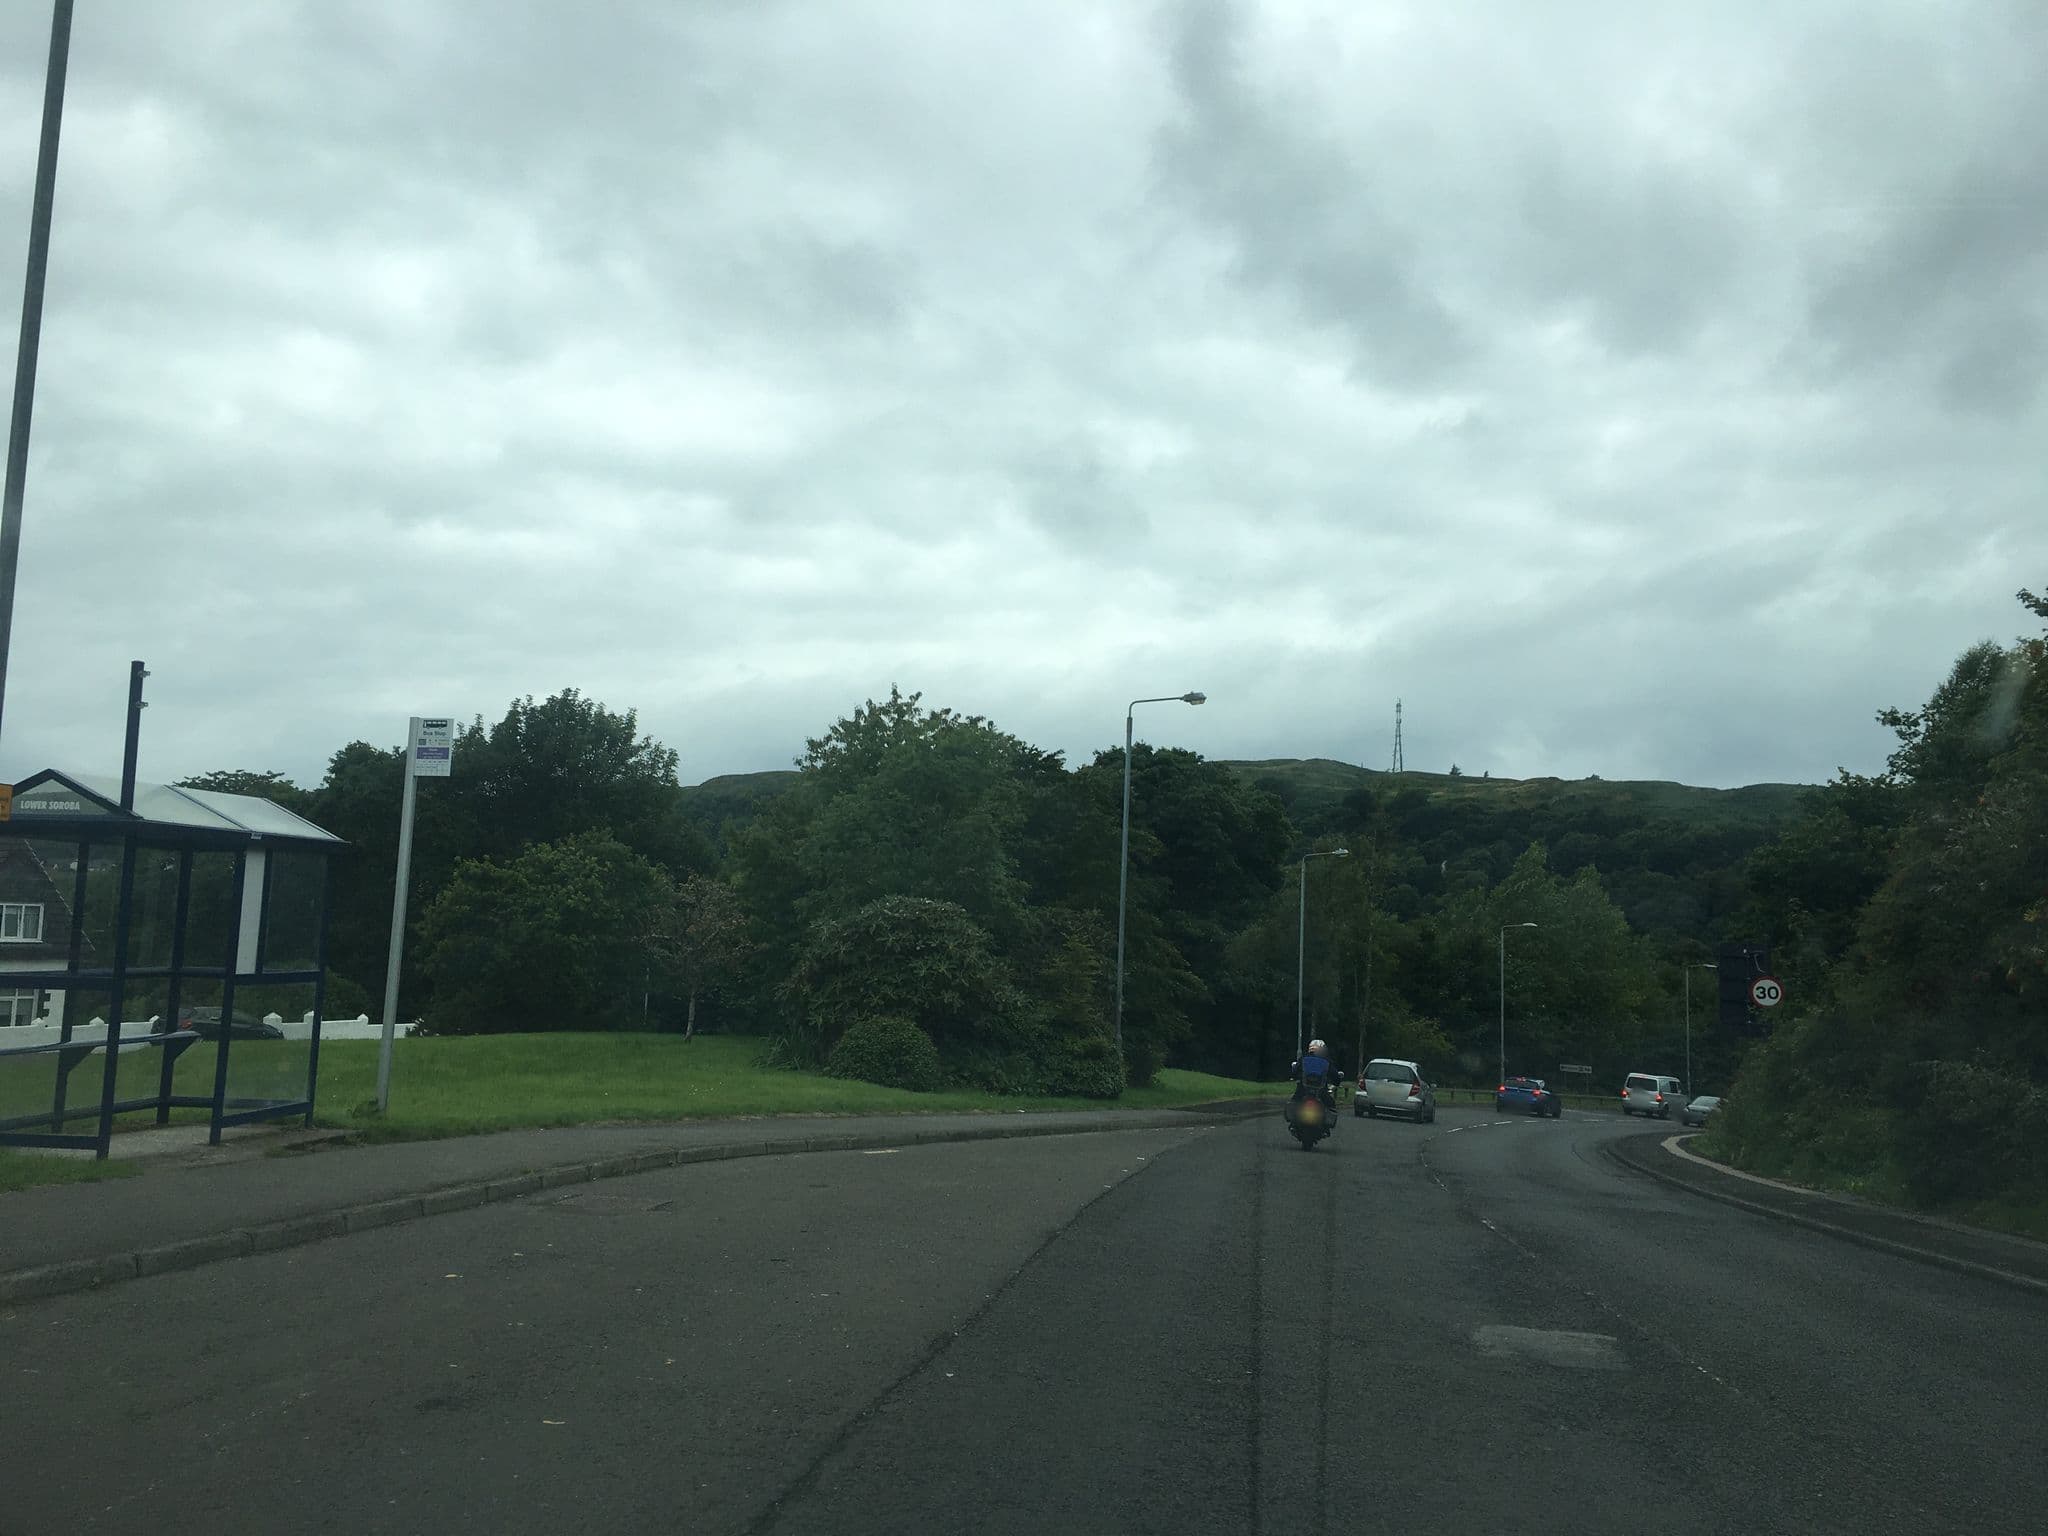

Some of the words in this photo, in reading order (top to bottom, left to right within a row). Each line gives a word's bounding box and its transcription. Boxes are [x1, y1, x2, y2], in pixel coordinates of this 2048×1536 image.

[20, 800, 47, 810] LOWER
[48, 801, 80, 811] SOROBA
[1755, 986, 1779, 1000] 30
